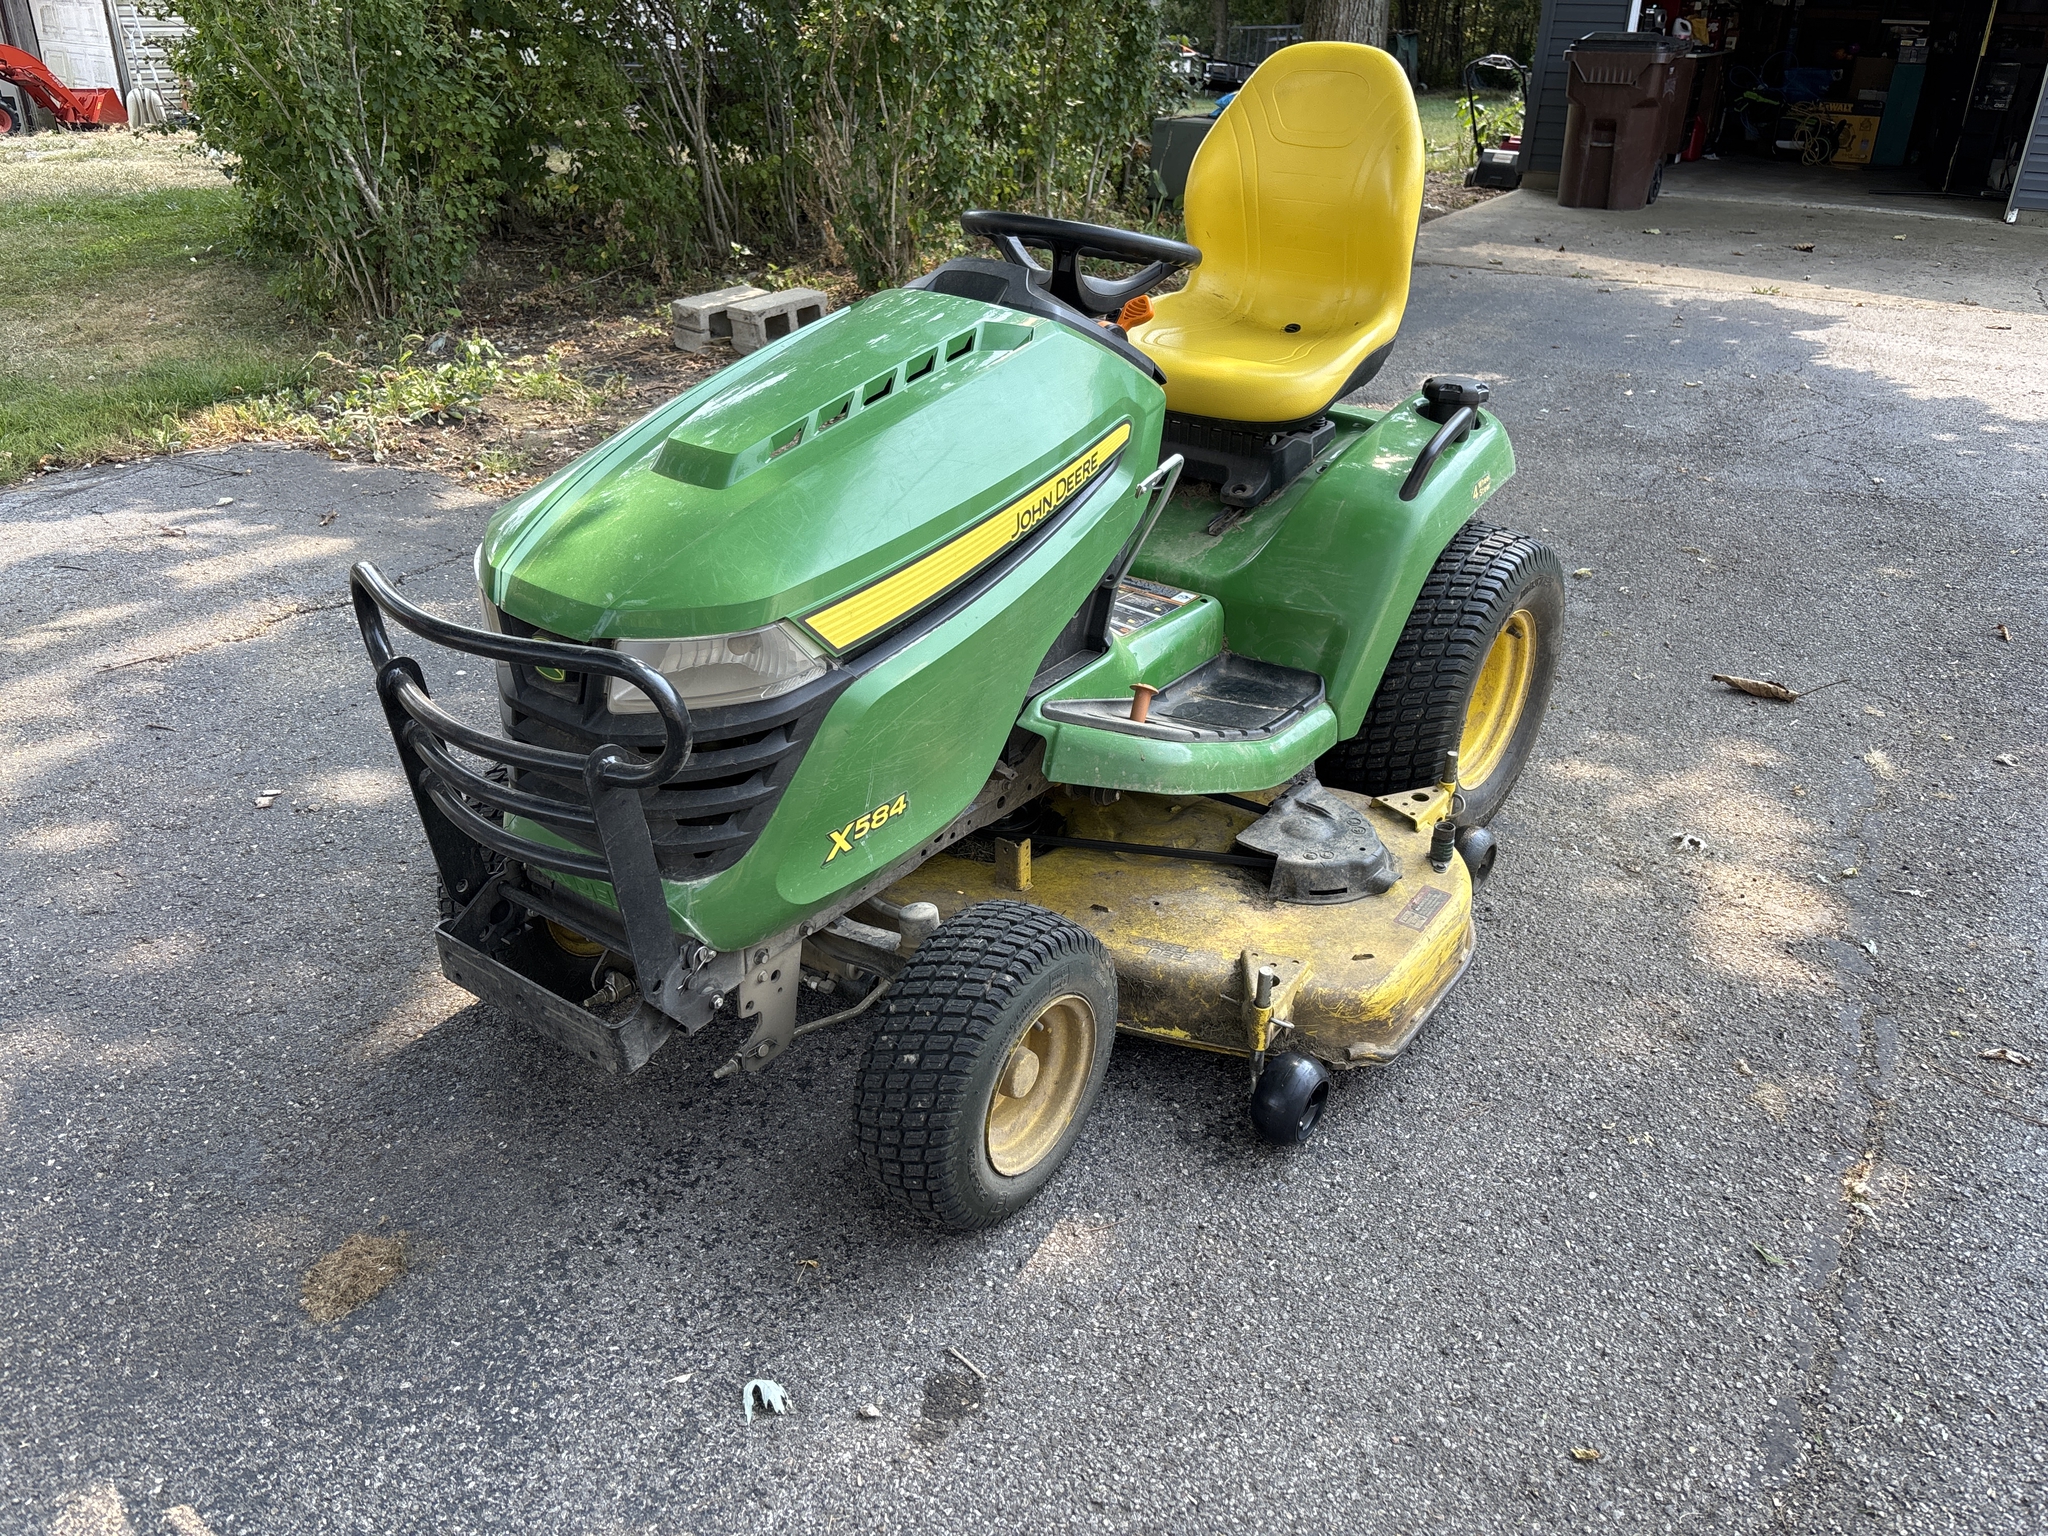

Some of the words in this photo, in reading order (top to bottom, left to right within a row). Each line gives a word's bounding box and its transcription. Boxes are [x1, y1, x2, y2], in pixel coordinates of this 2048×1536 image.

[1010, 490, 1053, 539] JOHN
[1056, 451, 1099, 502] DEERE
[1472, 484, 1479, 500] 4
[823, 792, 908, 865] X584
